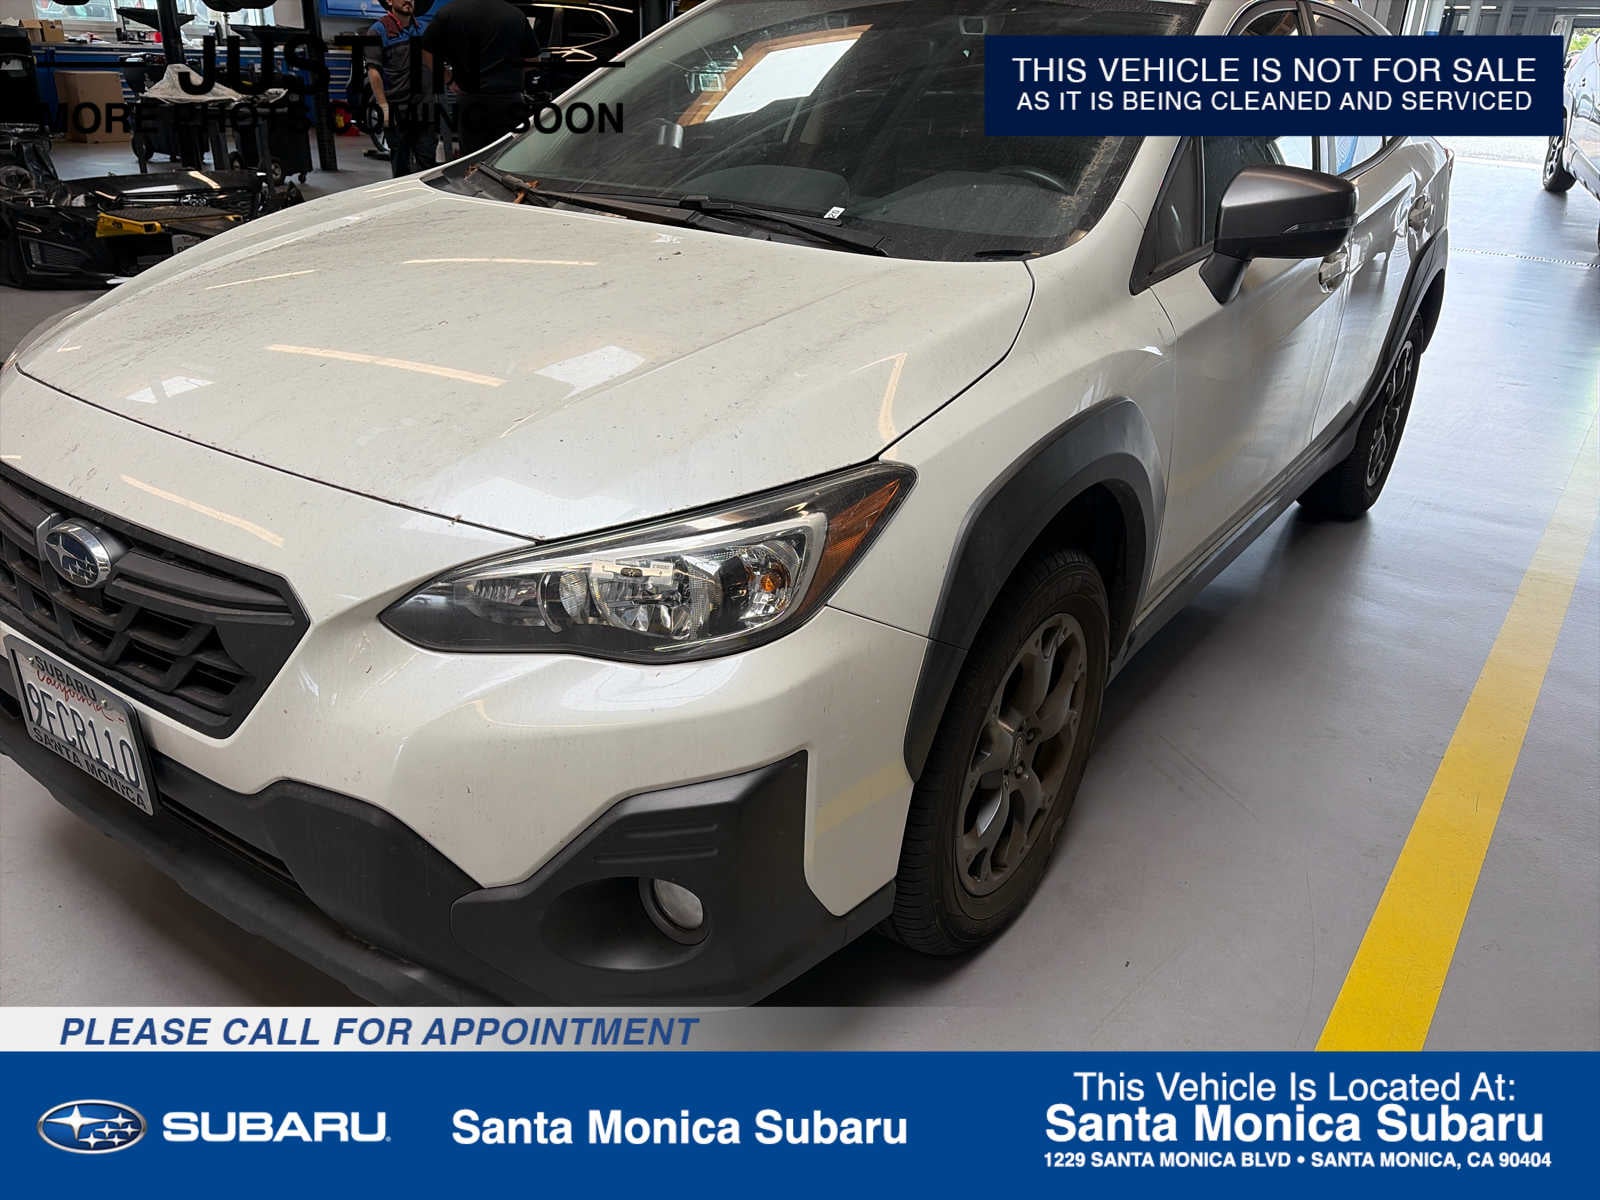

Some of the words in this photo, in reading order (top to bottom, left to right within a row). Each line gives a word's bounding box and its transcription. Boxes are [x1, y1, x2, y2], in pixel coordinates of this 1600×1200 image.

[34, 655, 97, 702] SUBARU
[33, 727, 82, 768] SANTA
[84, 759, 148, 810] MONICA
